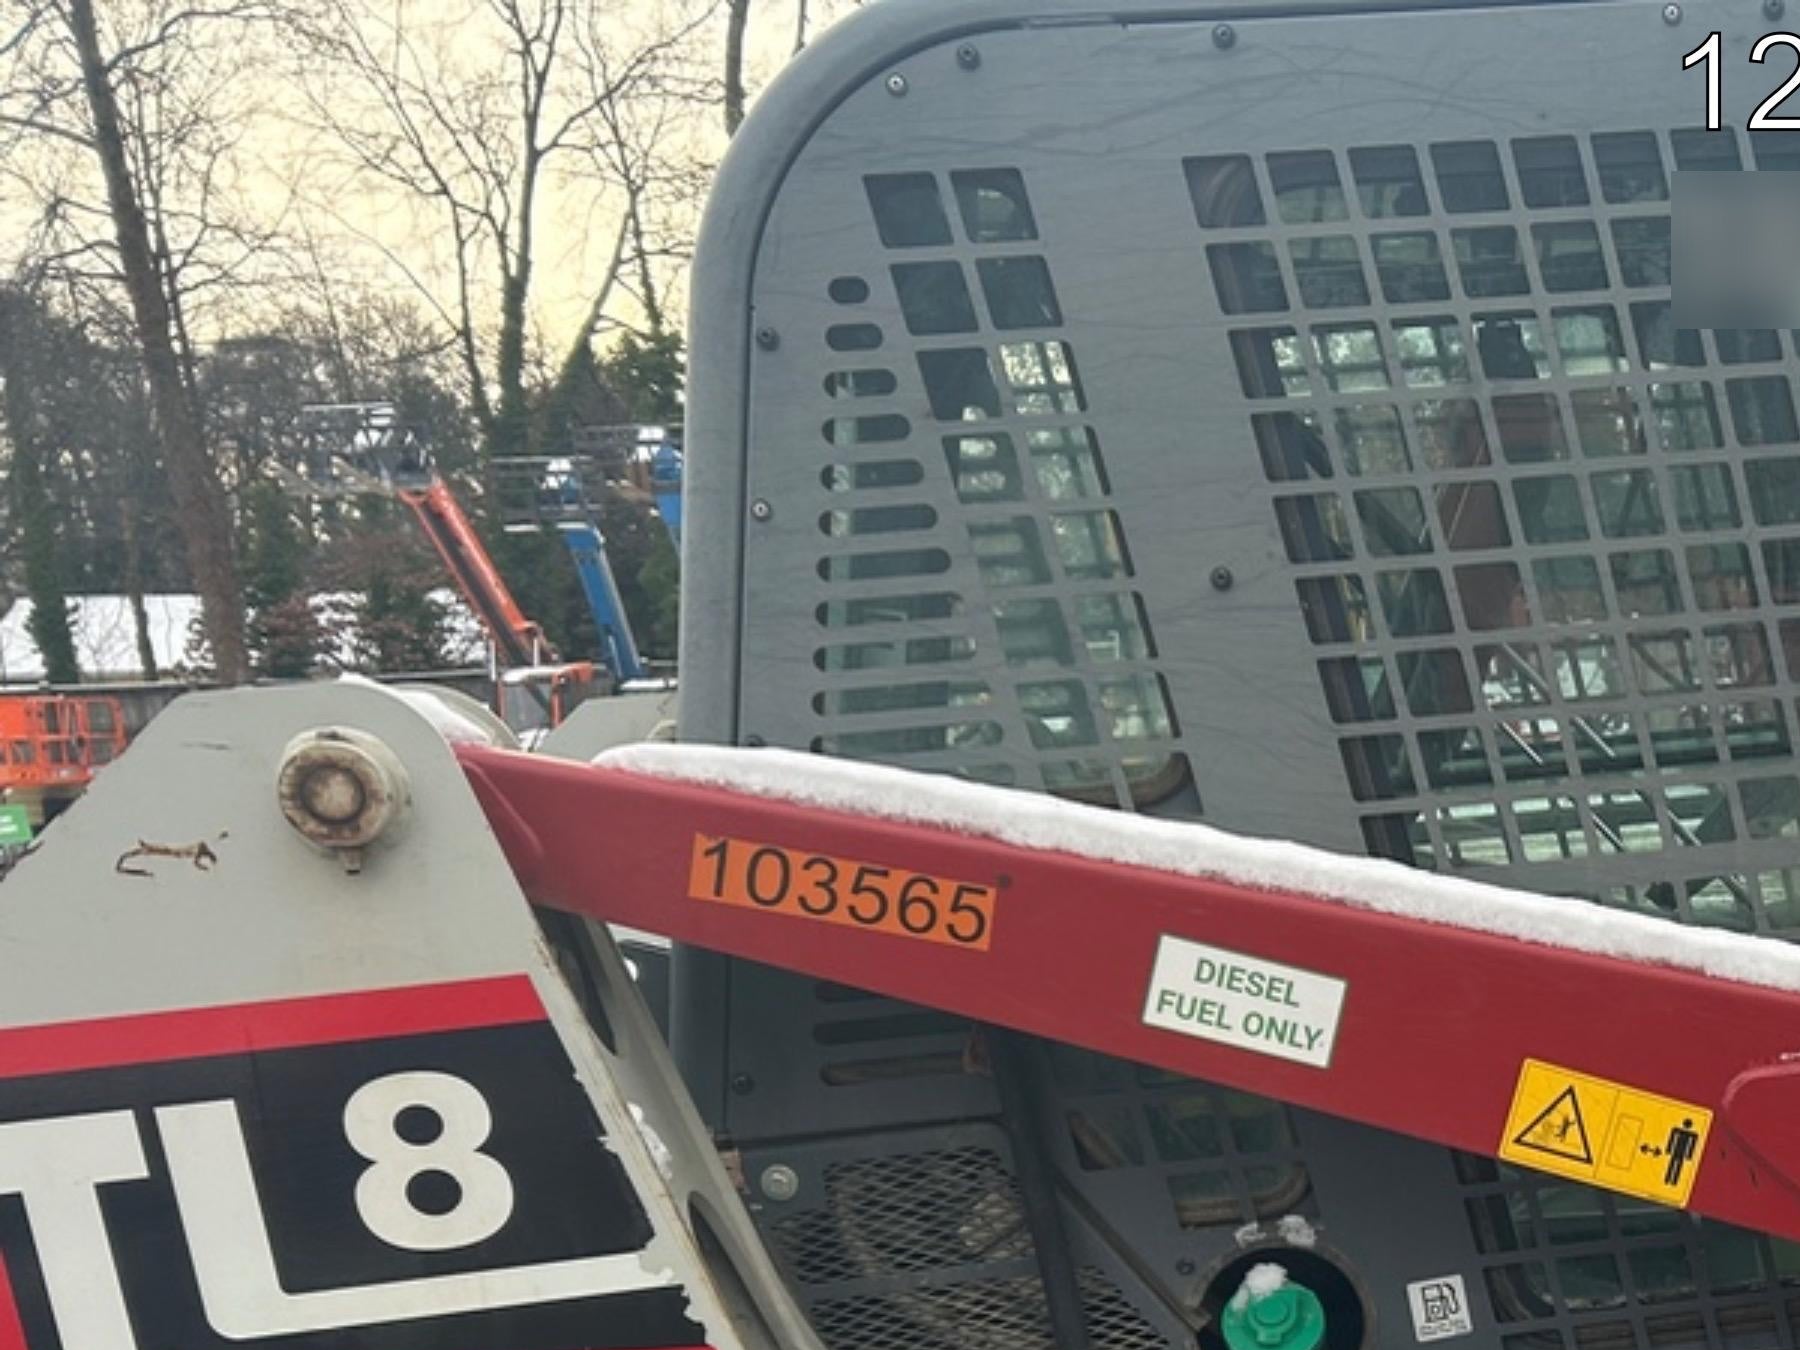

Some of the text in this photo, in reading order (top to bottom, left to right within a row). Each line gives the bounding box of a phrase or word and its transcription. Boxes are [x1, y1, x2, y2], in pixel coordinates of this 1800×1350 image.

[703, 838, 990, 944] 103565
[1193, 956, 1300, 1009] DIESEL
[1156, 988, 1324, 1051] FUEL ONLY
